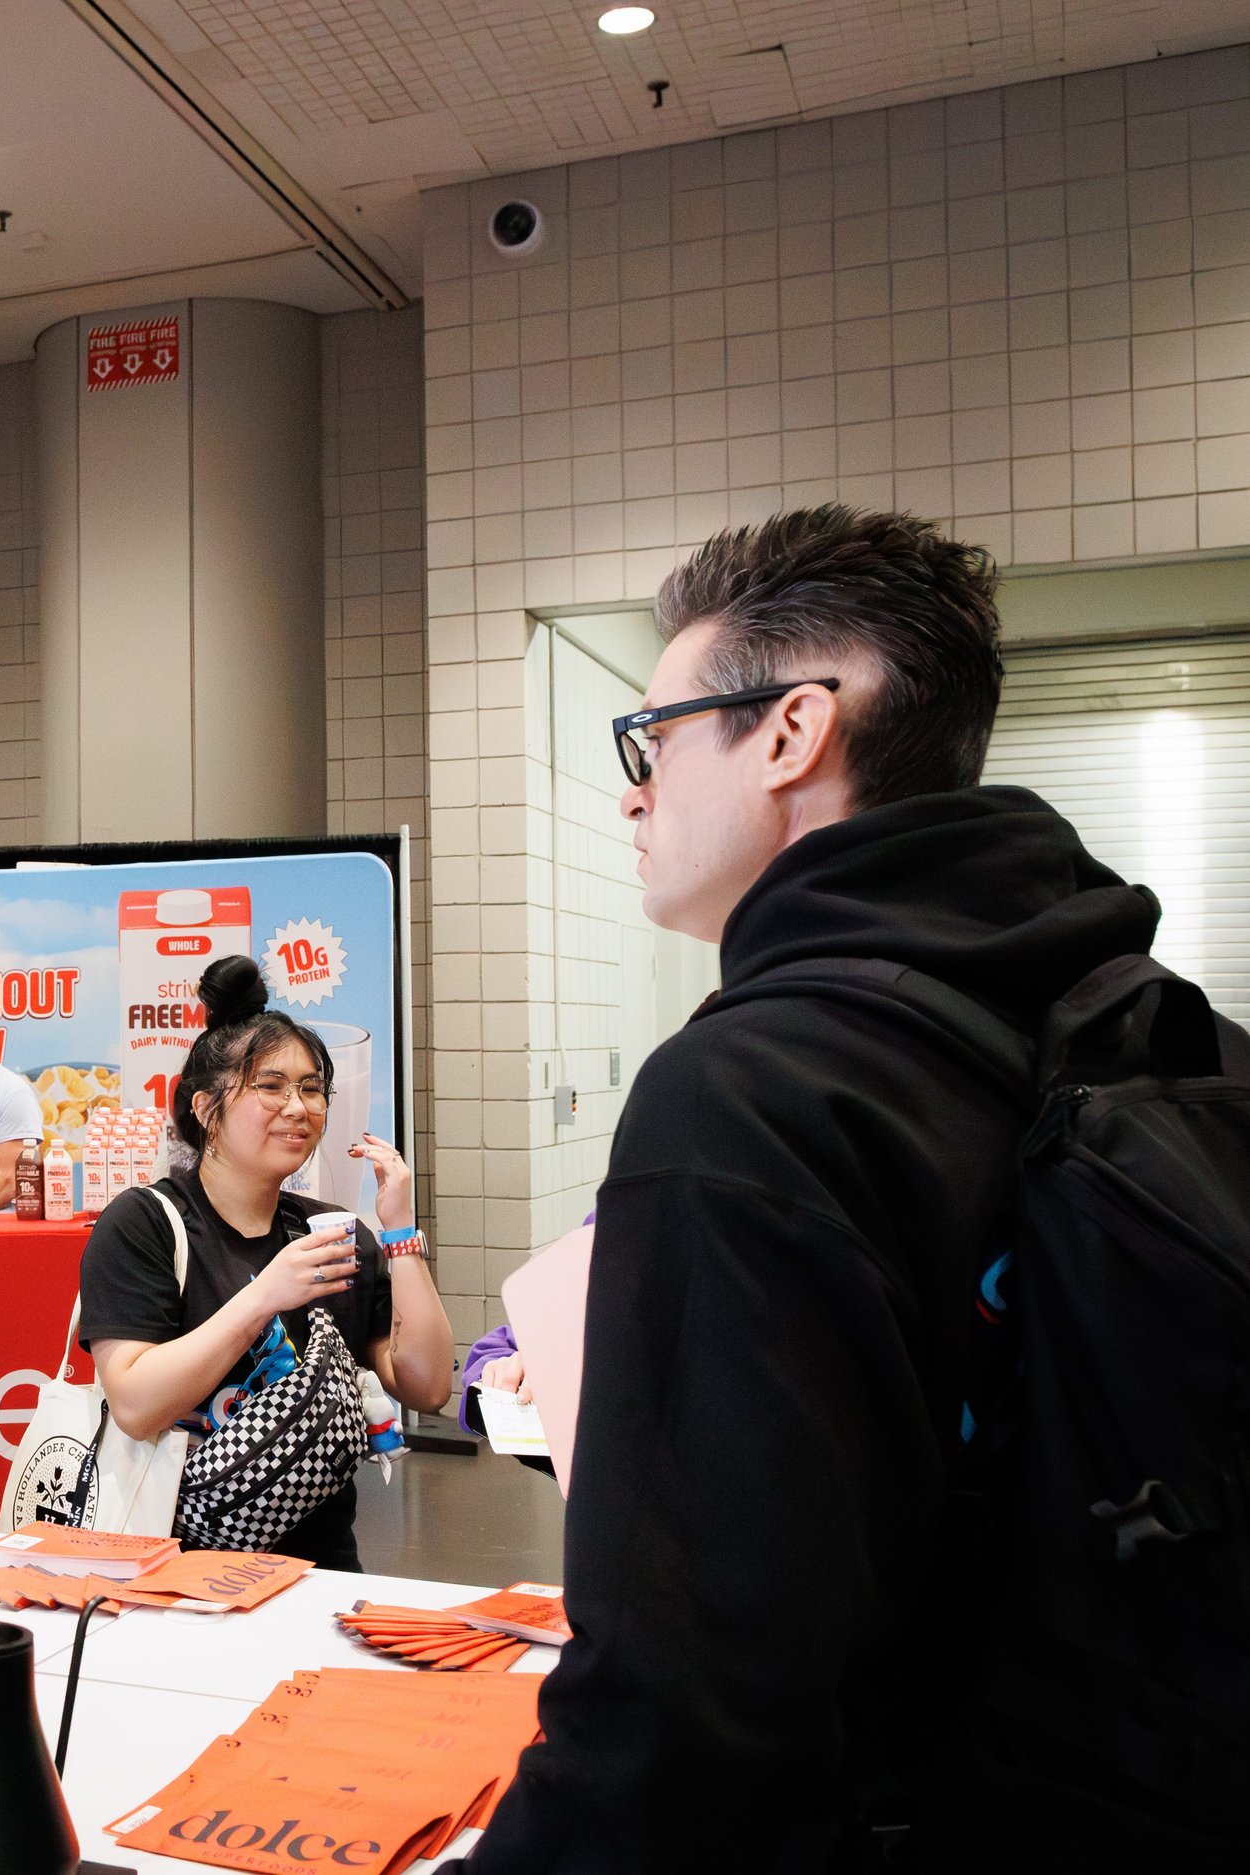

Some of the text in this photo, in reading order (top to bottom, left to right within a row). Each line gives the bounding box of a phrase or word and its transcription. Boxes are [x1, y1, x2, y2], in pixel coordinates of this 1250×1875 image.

[90, 325, 177, 350] FIRE FIRE FIRE
[168, 939, 200, 952] WHOLE
[276, 938, 329, 974] 10G
[157, 979, 200, 998] striv
[288, 967, 331, 987] PROTEIN
[128, 1003, 208, 1030] FREEM
[130, 1035, 194, 1050] DAIRY WITHO
[18, 1442, 65, 1501] HOLLANDER
[81, 1442, 97, 1483] MONIN
[202, 1554, 288, 1596] dolce
[168, 1809, 381, 1867] dolce
